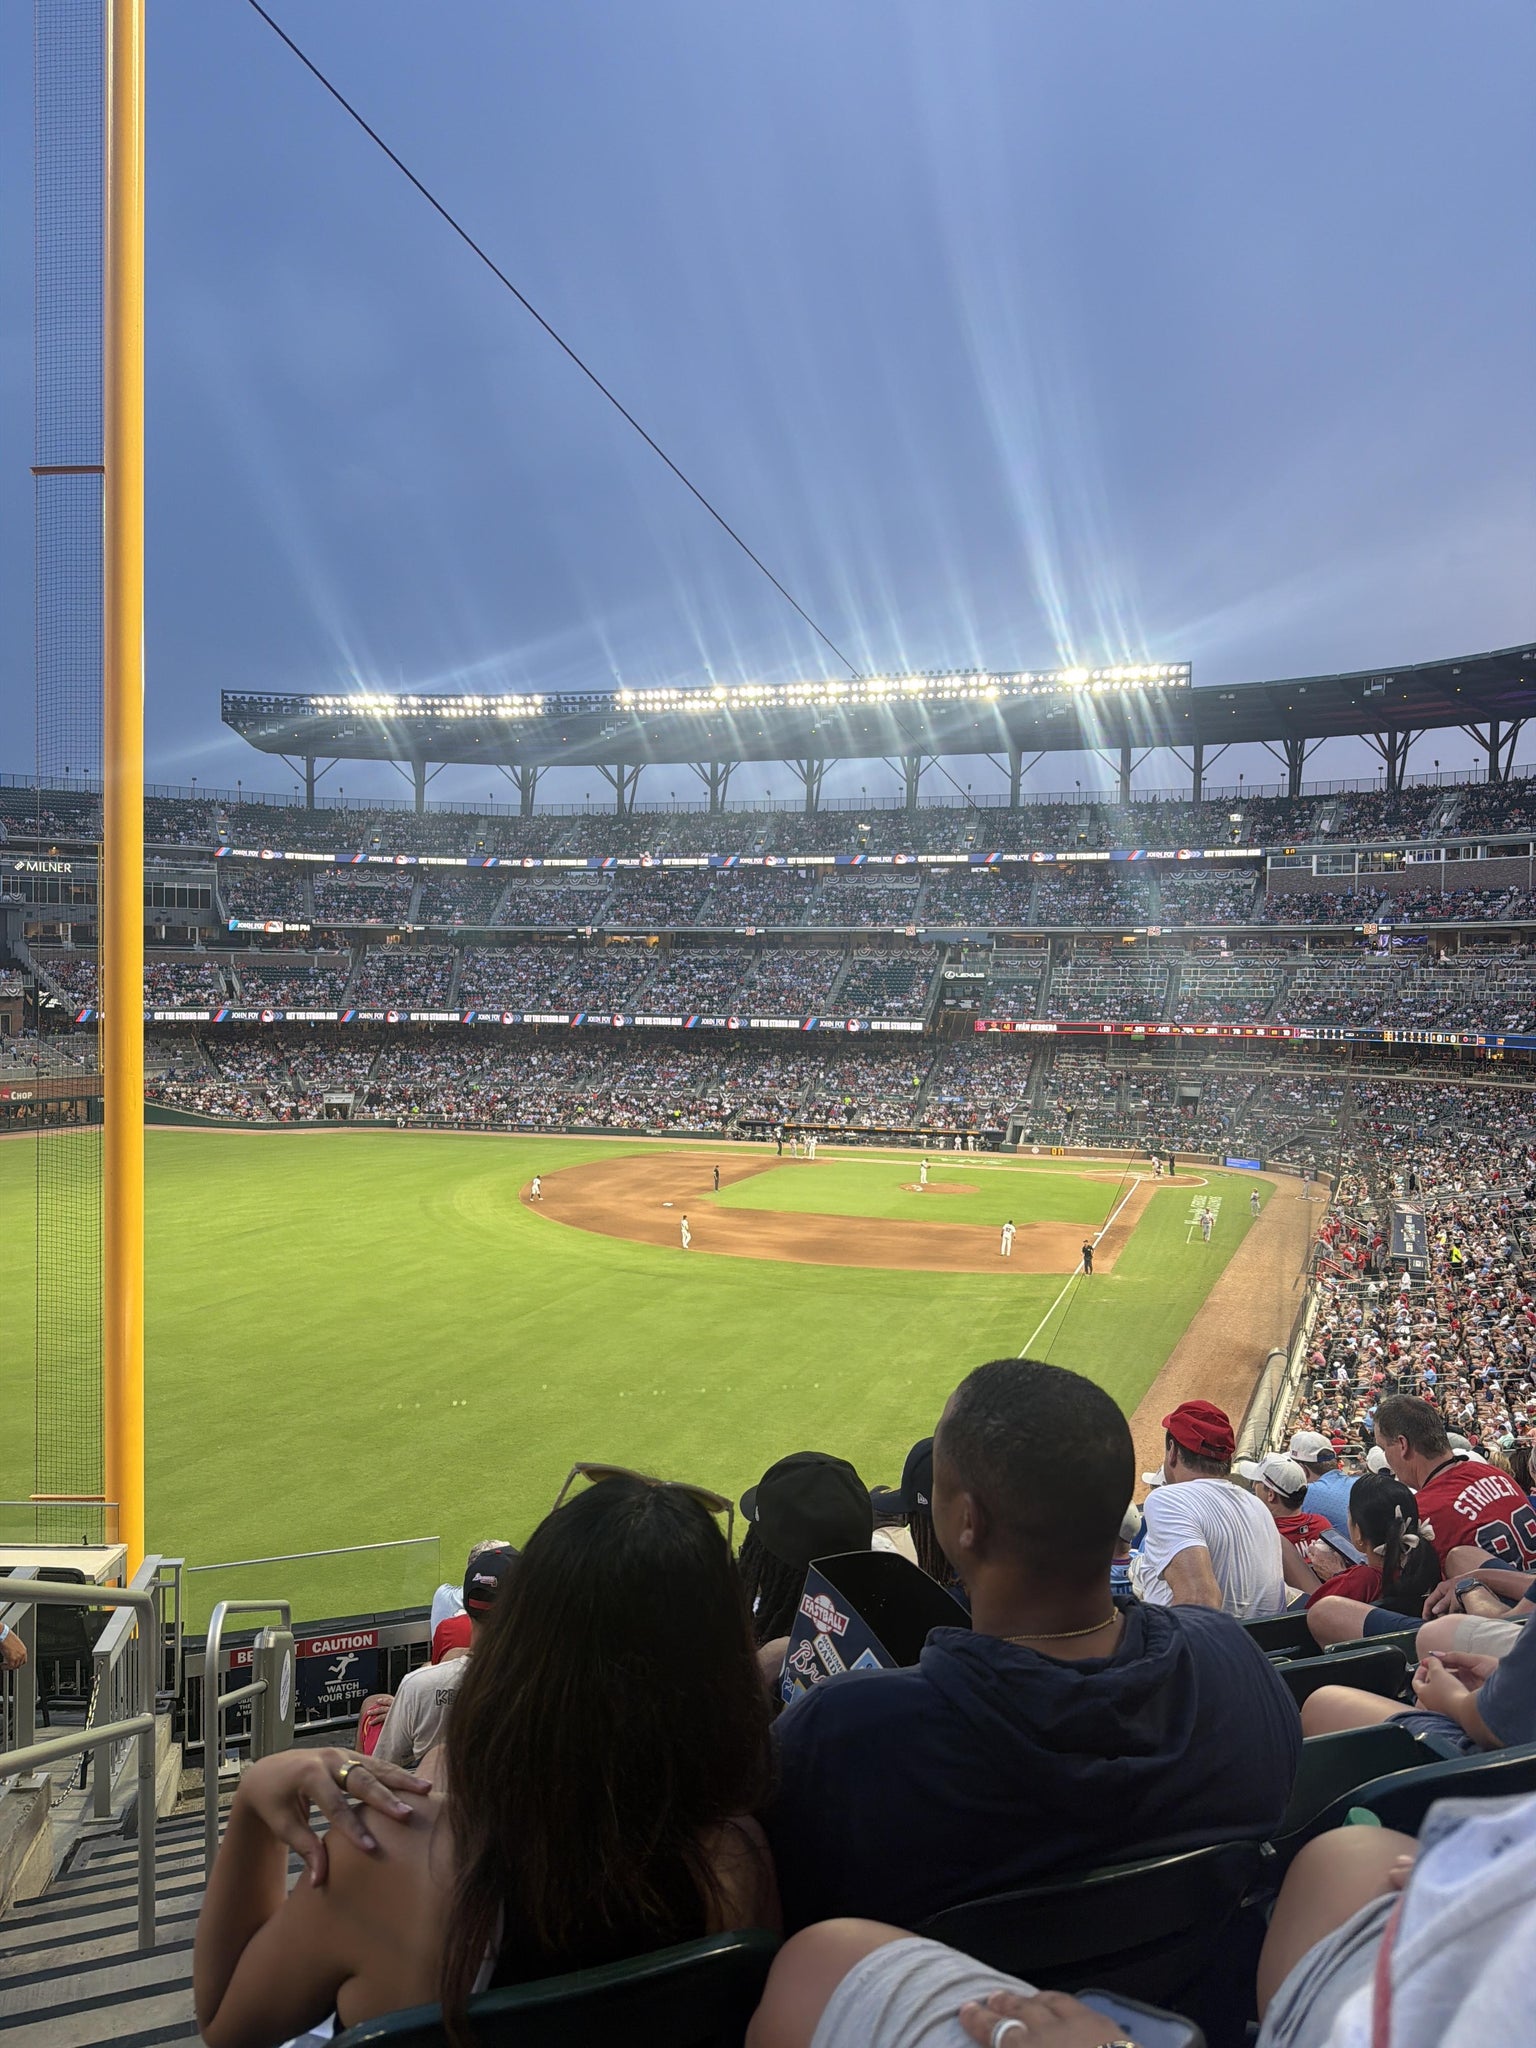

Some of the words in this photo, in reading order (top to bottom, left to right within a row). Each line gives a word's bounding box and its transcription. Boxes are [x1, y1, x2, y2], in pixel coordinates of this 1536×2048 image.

[26, 861, 72, 873] MILNER
[248, 1012, 259, 1020] FOY
[358, 1012, 373, 1020] JOHN
[491, 1014, 500, 1022] FOY
[602, 1016, 611, 1024] FOY
[716, 1018, 726, 1026] FOY
[819, 1020, 834, 1028] JOHN
[835, 1020, 845, 1029] FOY
[11, 1091, 33, 1100] CHOP
[1453, 1475, 1519, 1521] STRIDER
[803, 1598, 843, 1630] FASTBALL
[312, 1633, 373, 1654] CAUTION
[326, 1681, 360, 1694] WATCH
[317, 1691, 343, 1704] YOUR
[345, 1688, 369, 1700] STEP
